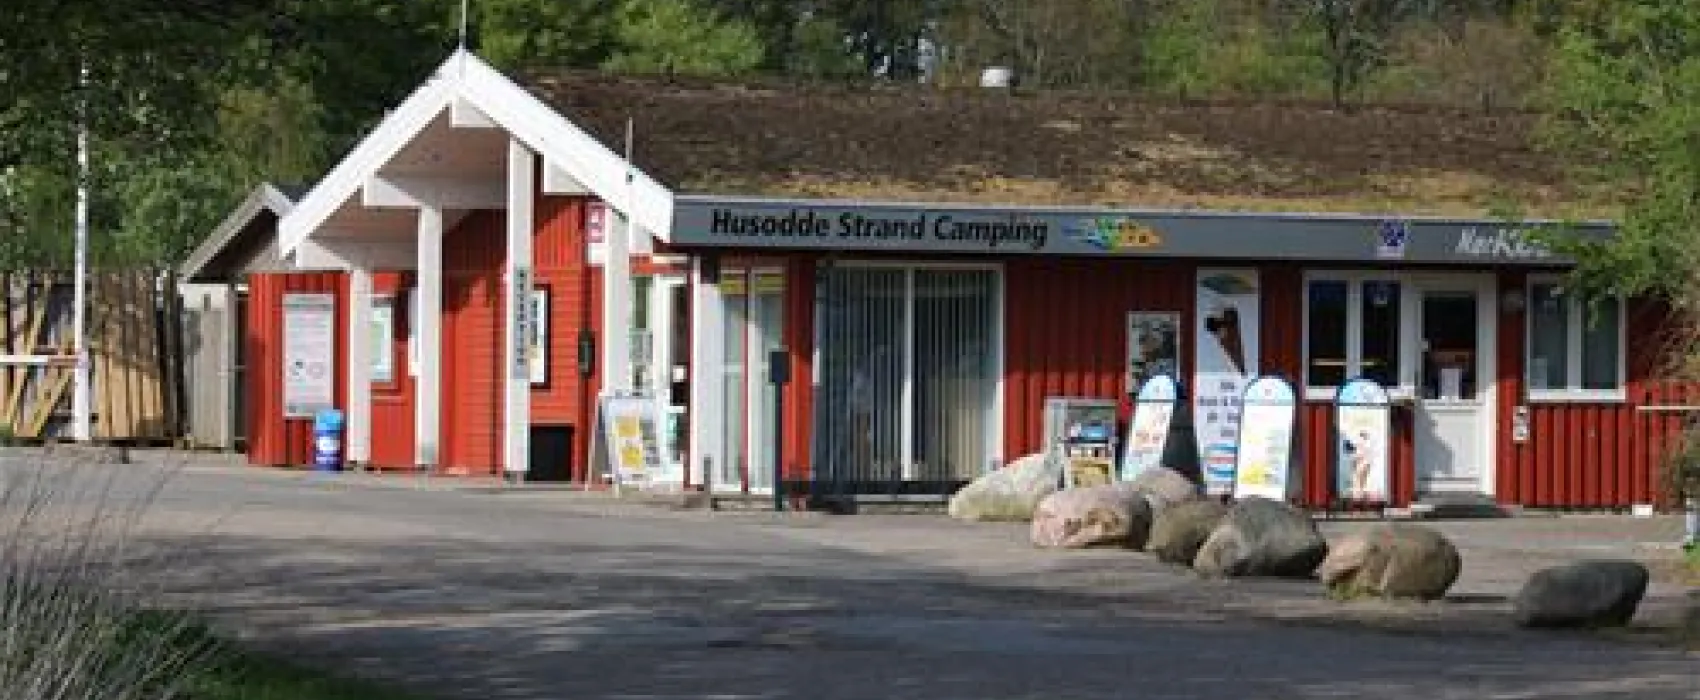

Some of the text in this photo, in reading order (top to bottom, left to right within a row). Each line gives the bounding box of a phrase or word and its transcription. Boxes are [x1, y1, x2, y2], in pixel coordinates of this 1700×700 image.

[710, 208, 1049, 249] Husodde Strand Camping
